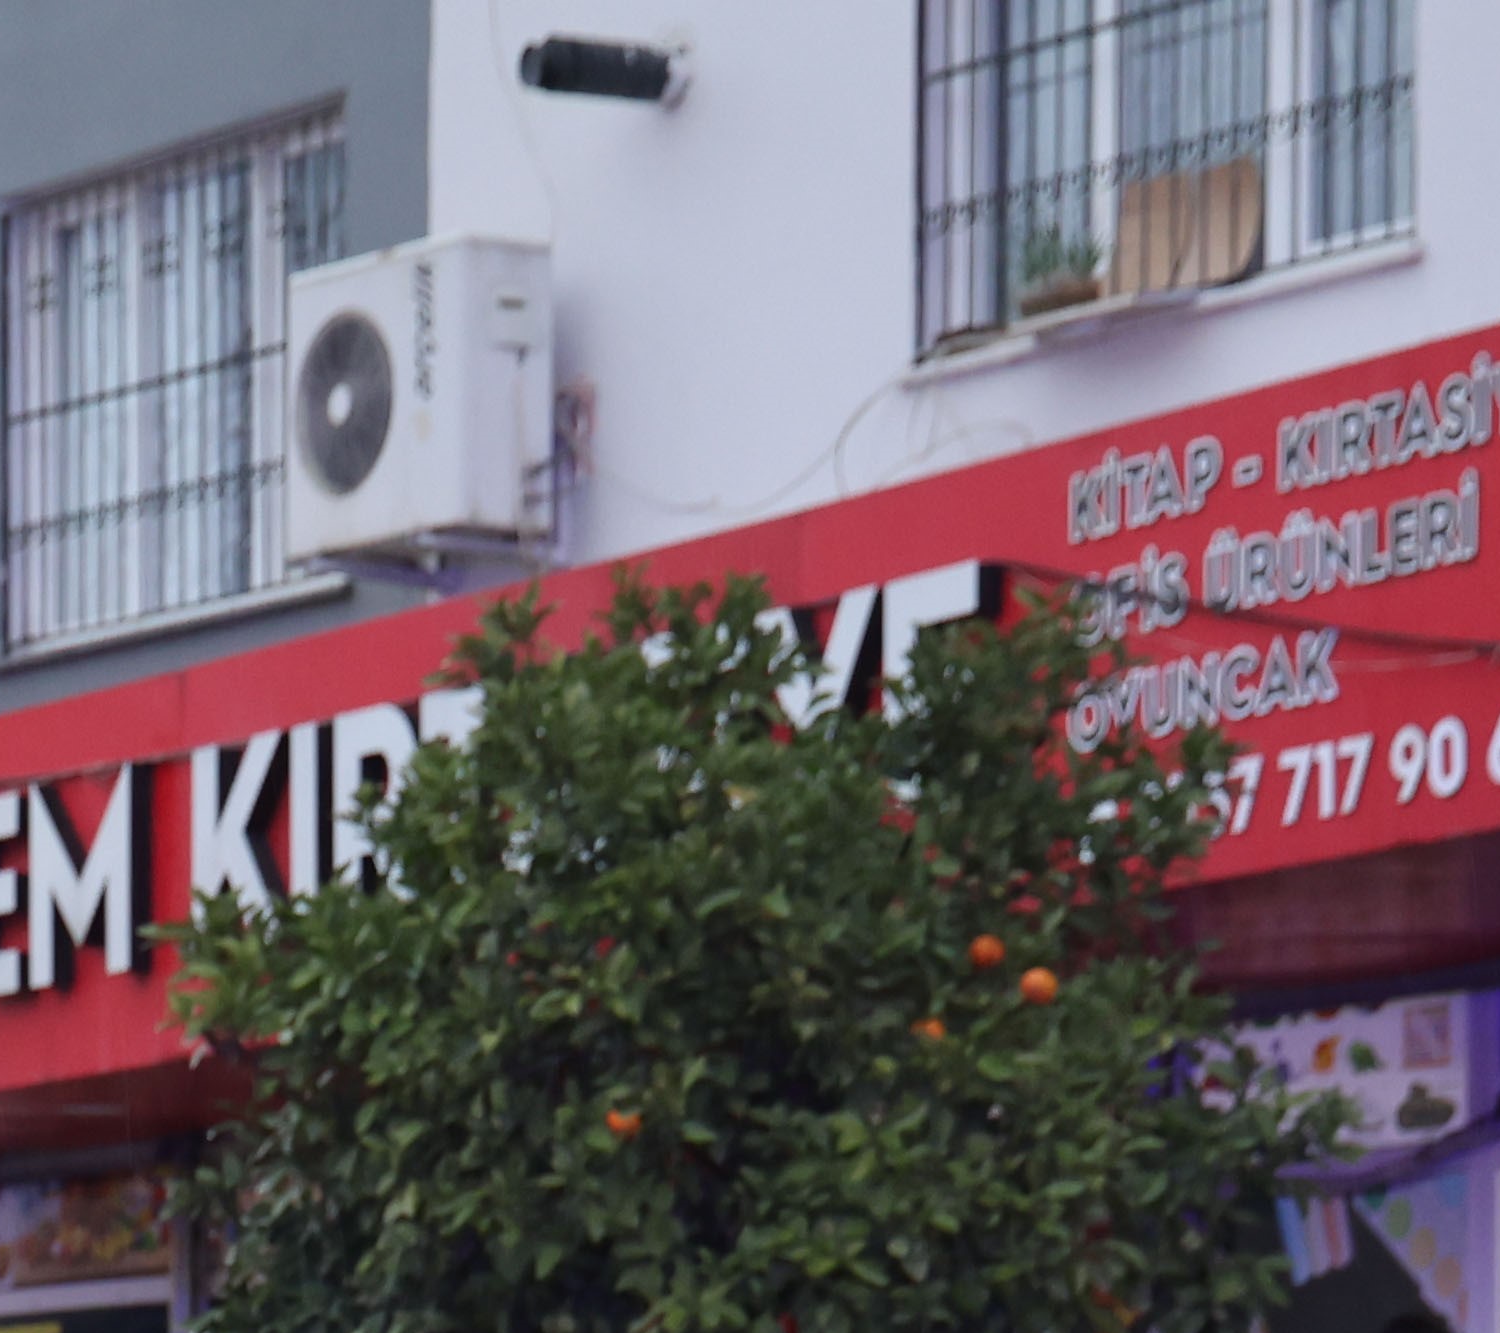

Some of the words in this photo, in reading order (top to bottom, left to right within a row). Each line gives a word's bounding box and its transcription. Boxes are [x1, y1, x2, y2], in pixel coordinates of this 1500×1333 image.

[1067, 436, 1222, 544] KİTAP
[1073, 544, 1189, 647] OFİS
[1203, 467, 1479, 612] ÜRÜNLERİ
[1066, 626, 1340, 754] OYUNCAK
[1278, 732, 1373, 826] 717
[1390, 714, 1468, 804] 90
